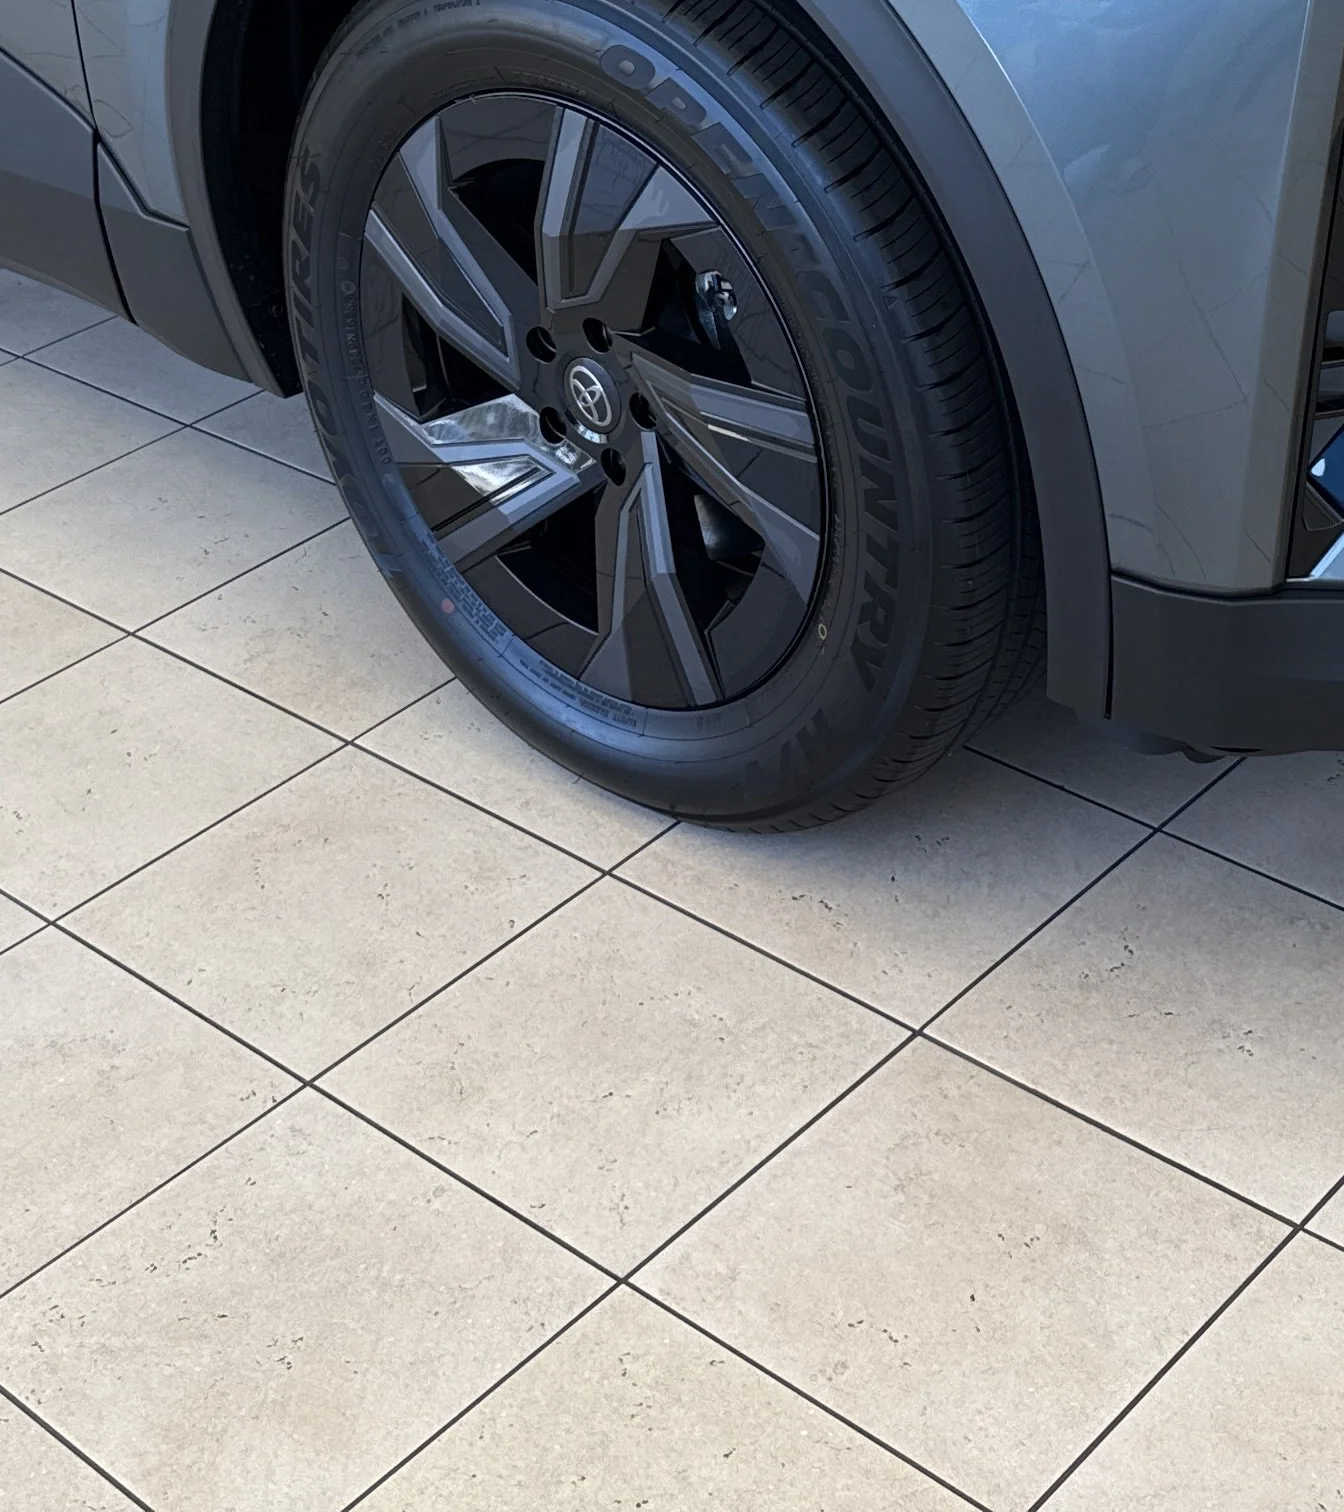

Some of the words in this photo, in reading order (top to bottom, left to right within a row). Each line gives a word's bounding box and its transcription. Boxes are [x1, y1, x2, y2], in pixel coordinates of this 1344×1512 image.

[290, 142, 321, 365] TIRES
[599, 44, 797, 227] OPEN
[805, 271, 900, 694] COUNTRY
